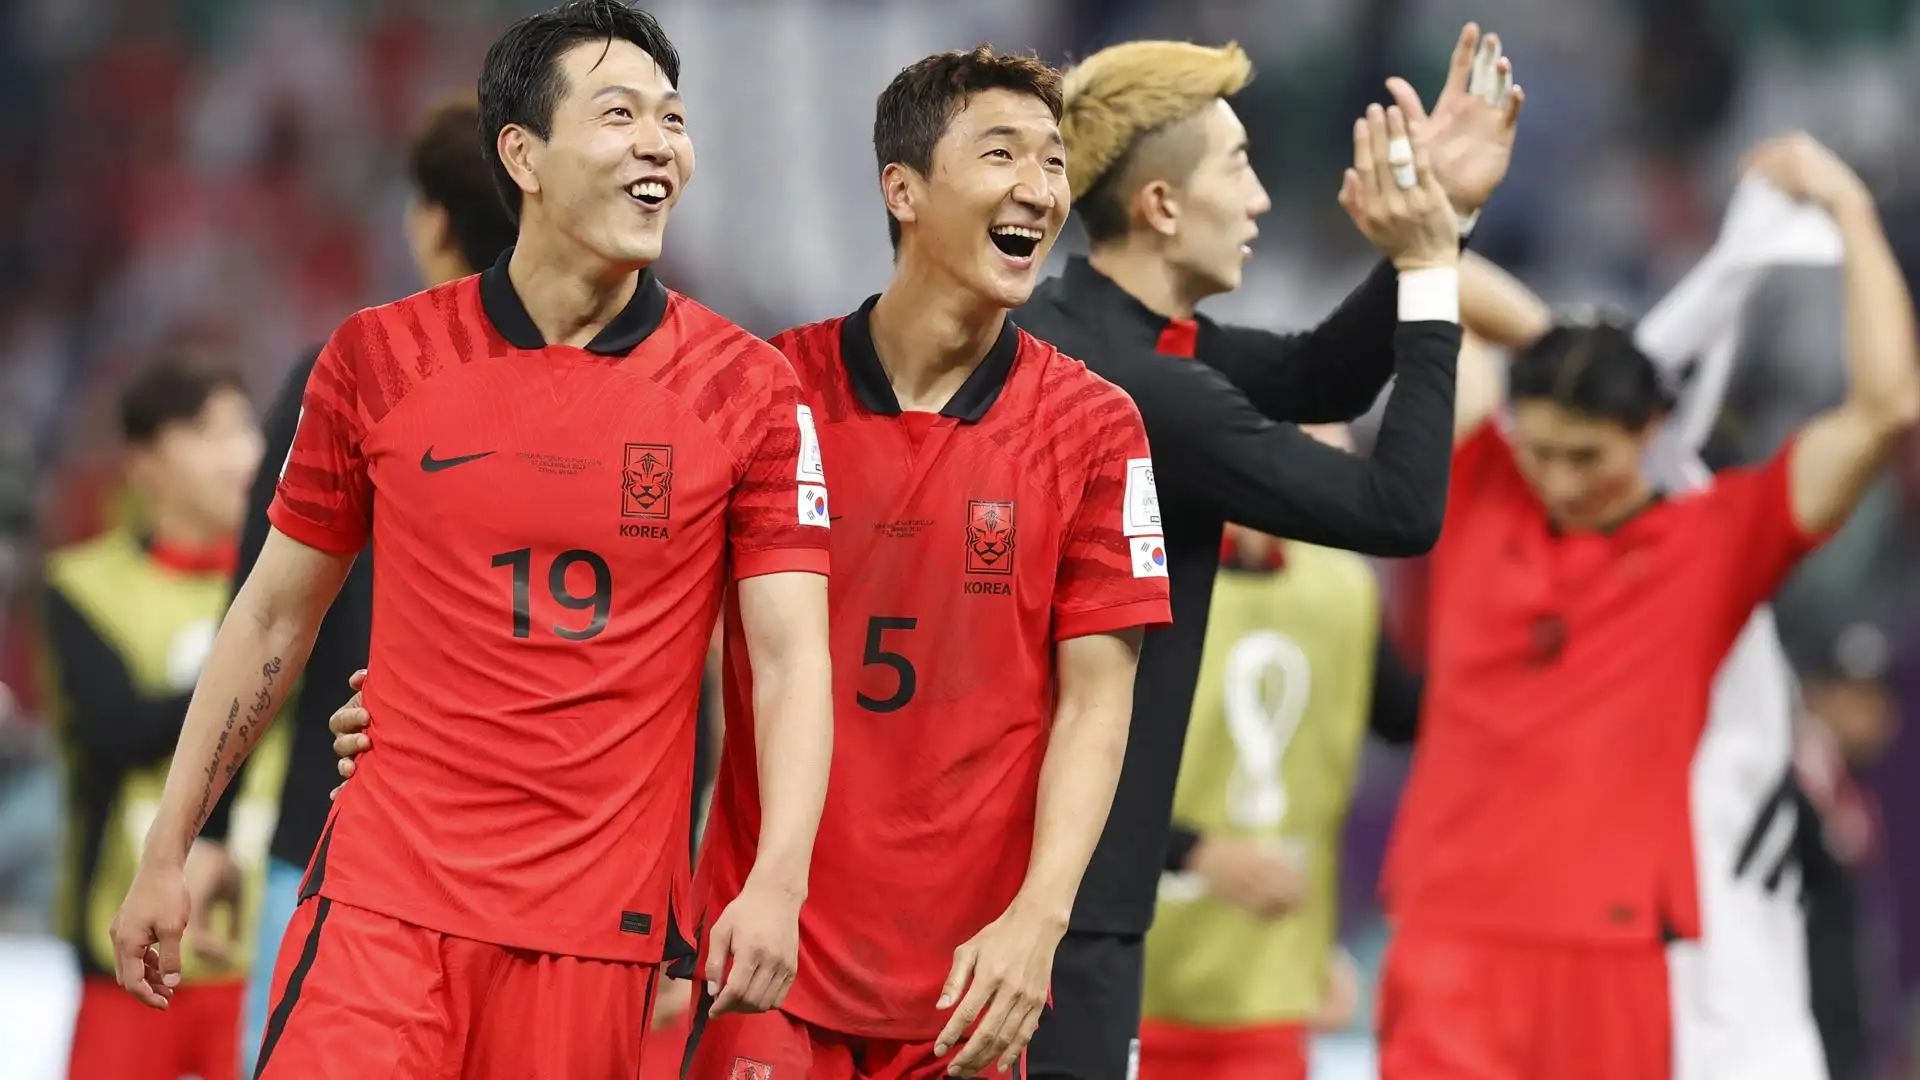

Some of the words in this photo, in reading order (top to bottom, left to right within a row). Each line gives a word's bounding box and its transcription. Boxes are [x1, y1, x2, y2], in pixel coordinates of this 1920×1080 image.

[619, 524, 669, 539] KOREA
[491, 547, 612, 641] 19
[964, 582, 1012, 595] KOREA
[856, 615, 918, 713] 5
